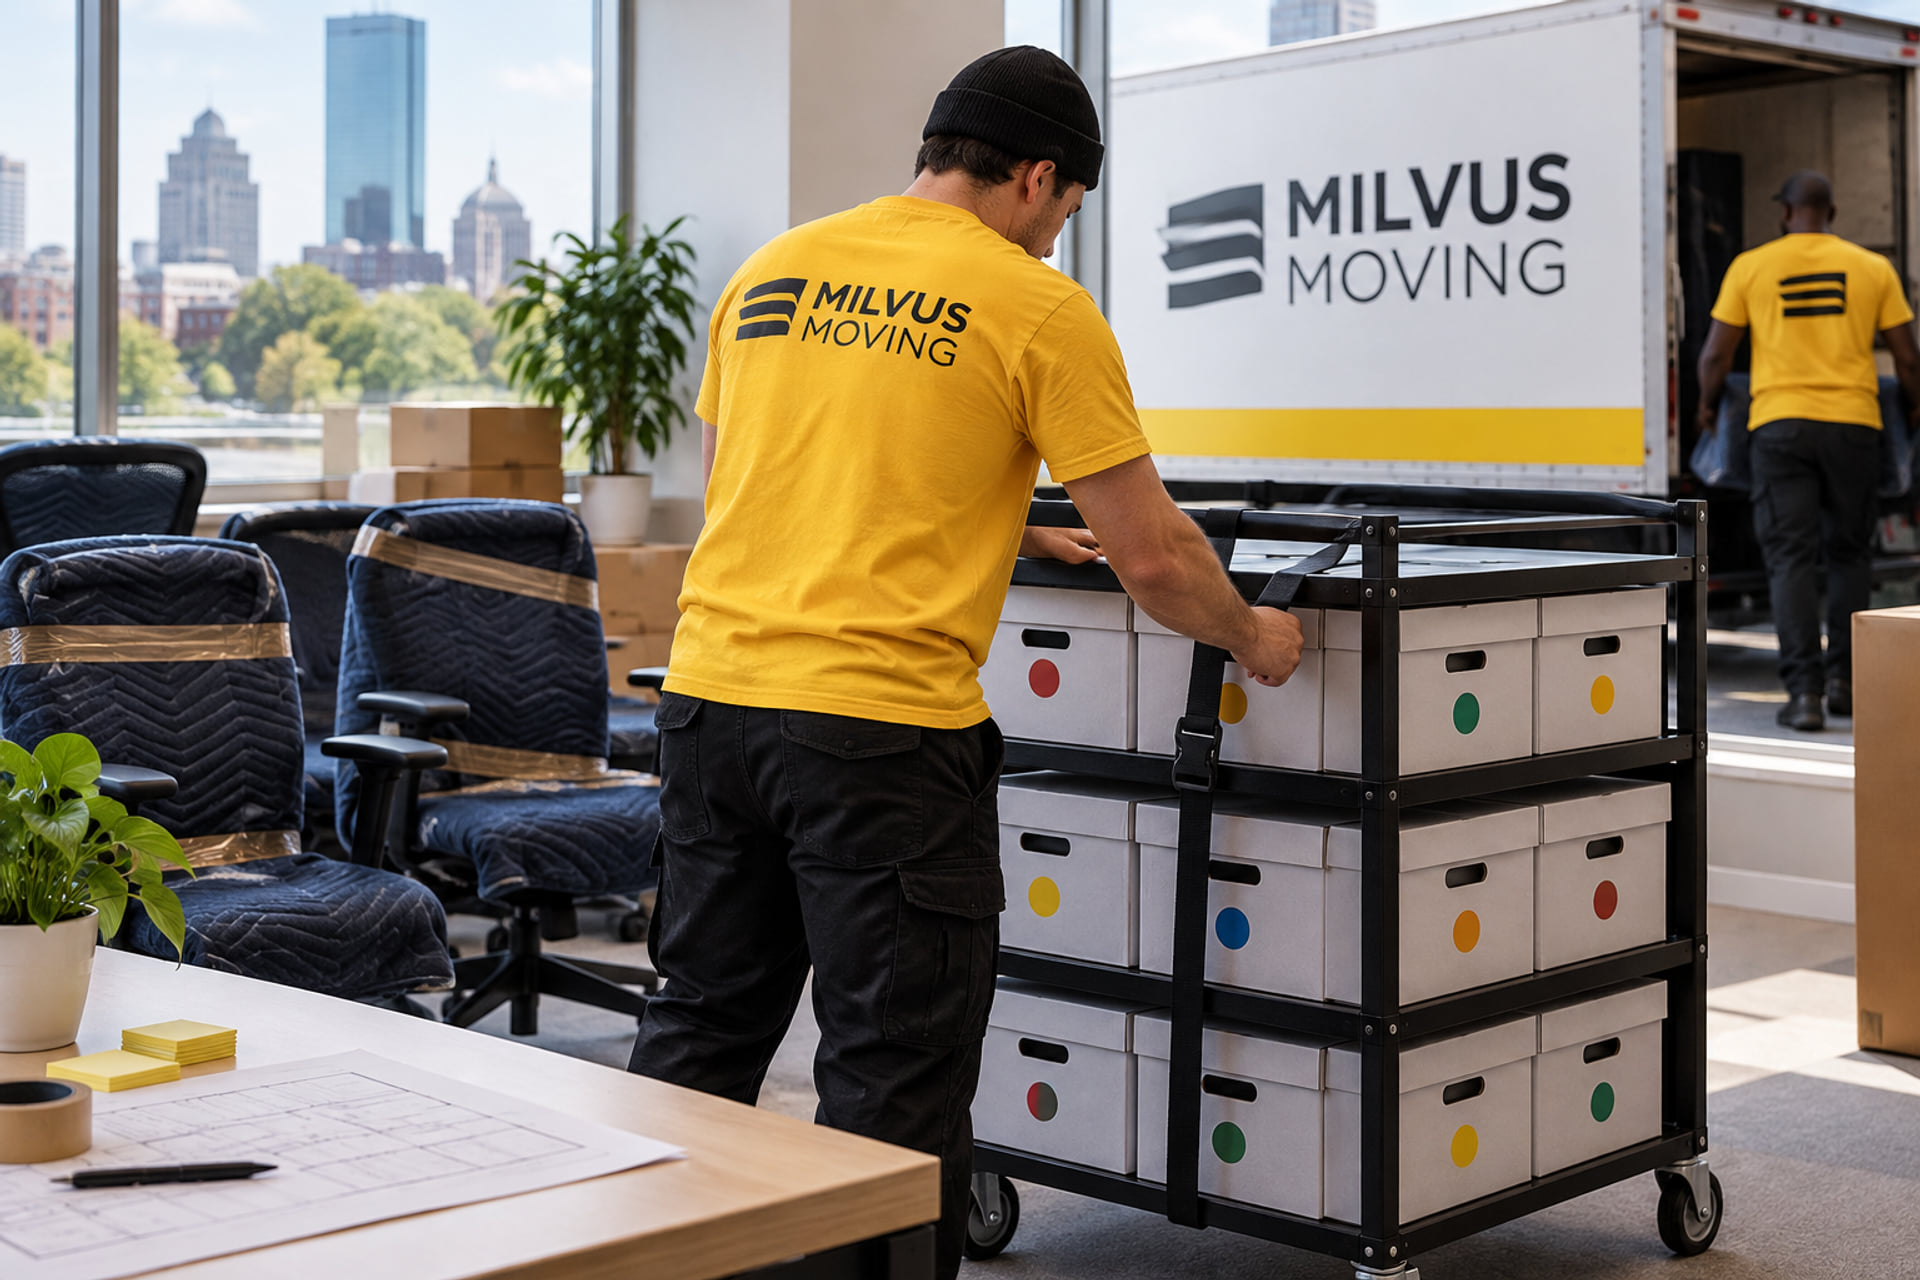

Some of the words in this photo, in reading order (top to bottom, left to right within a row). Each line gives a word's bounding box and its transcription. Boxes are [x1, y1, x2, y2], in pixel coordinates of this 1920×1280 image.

[1288, 152, 1572, 238] MILVUS
[1289, 238, 1567, 305] MOVING
[812, 281, 972, 334] MILVUS
[801, 315, 958, 367] MOVING
